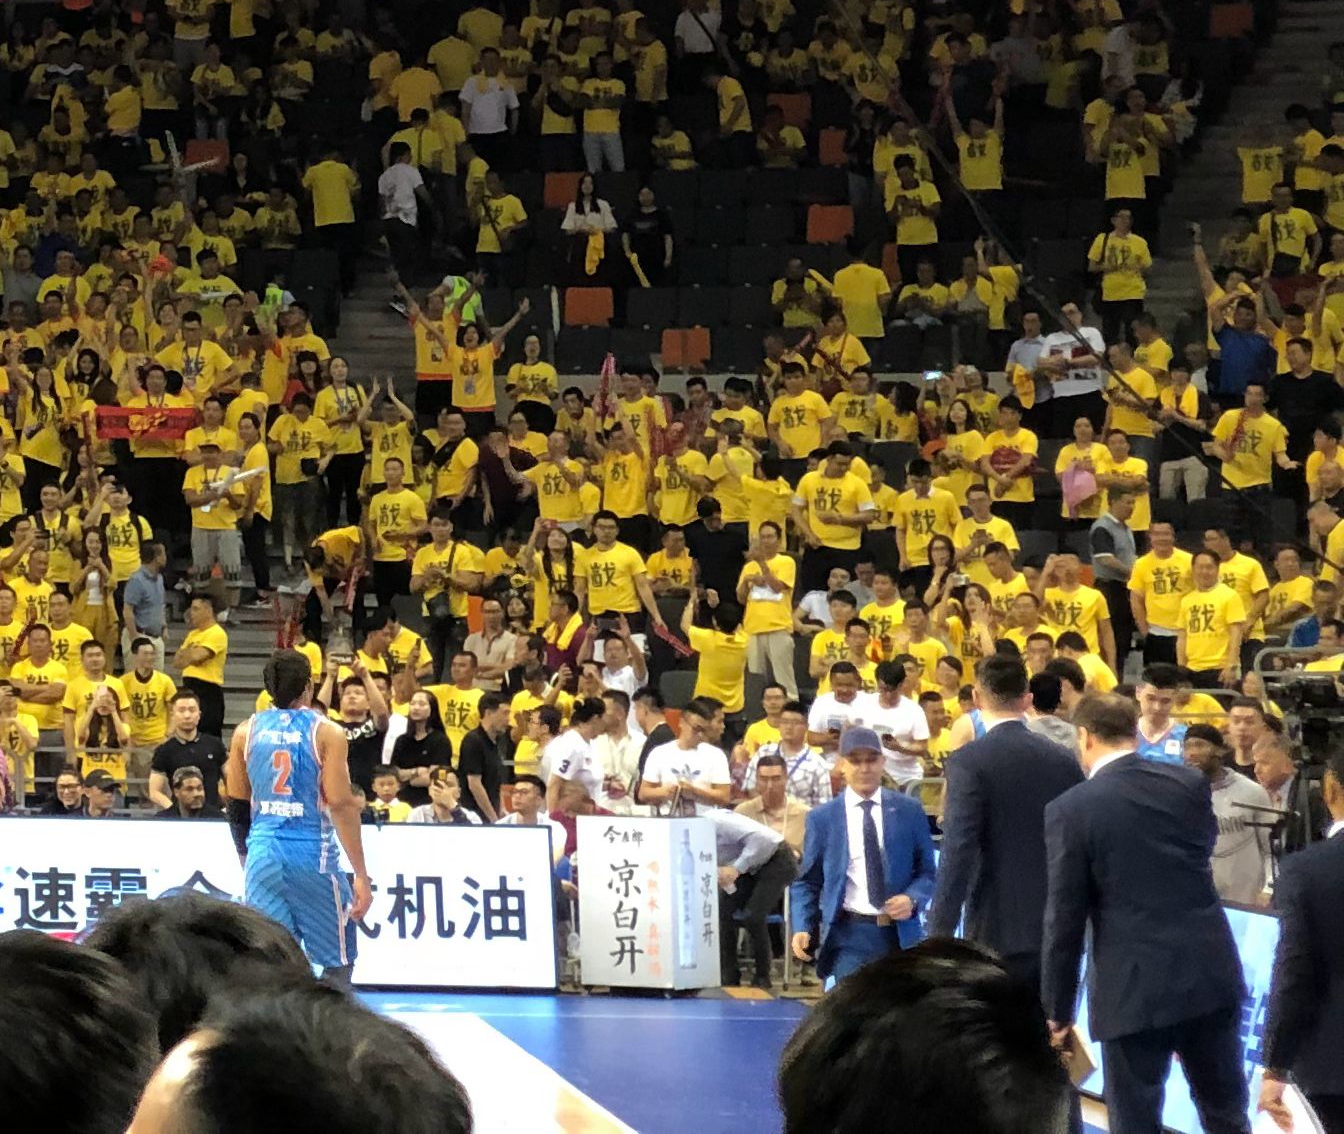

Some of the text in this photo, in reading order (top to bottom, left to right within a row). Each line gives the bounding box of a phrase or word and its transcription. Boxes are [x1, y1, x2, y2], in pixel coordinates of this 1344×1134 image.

[272, 750, 293, 794] 2
[607, 859, 644, 975] 凉白开
